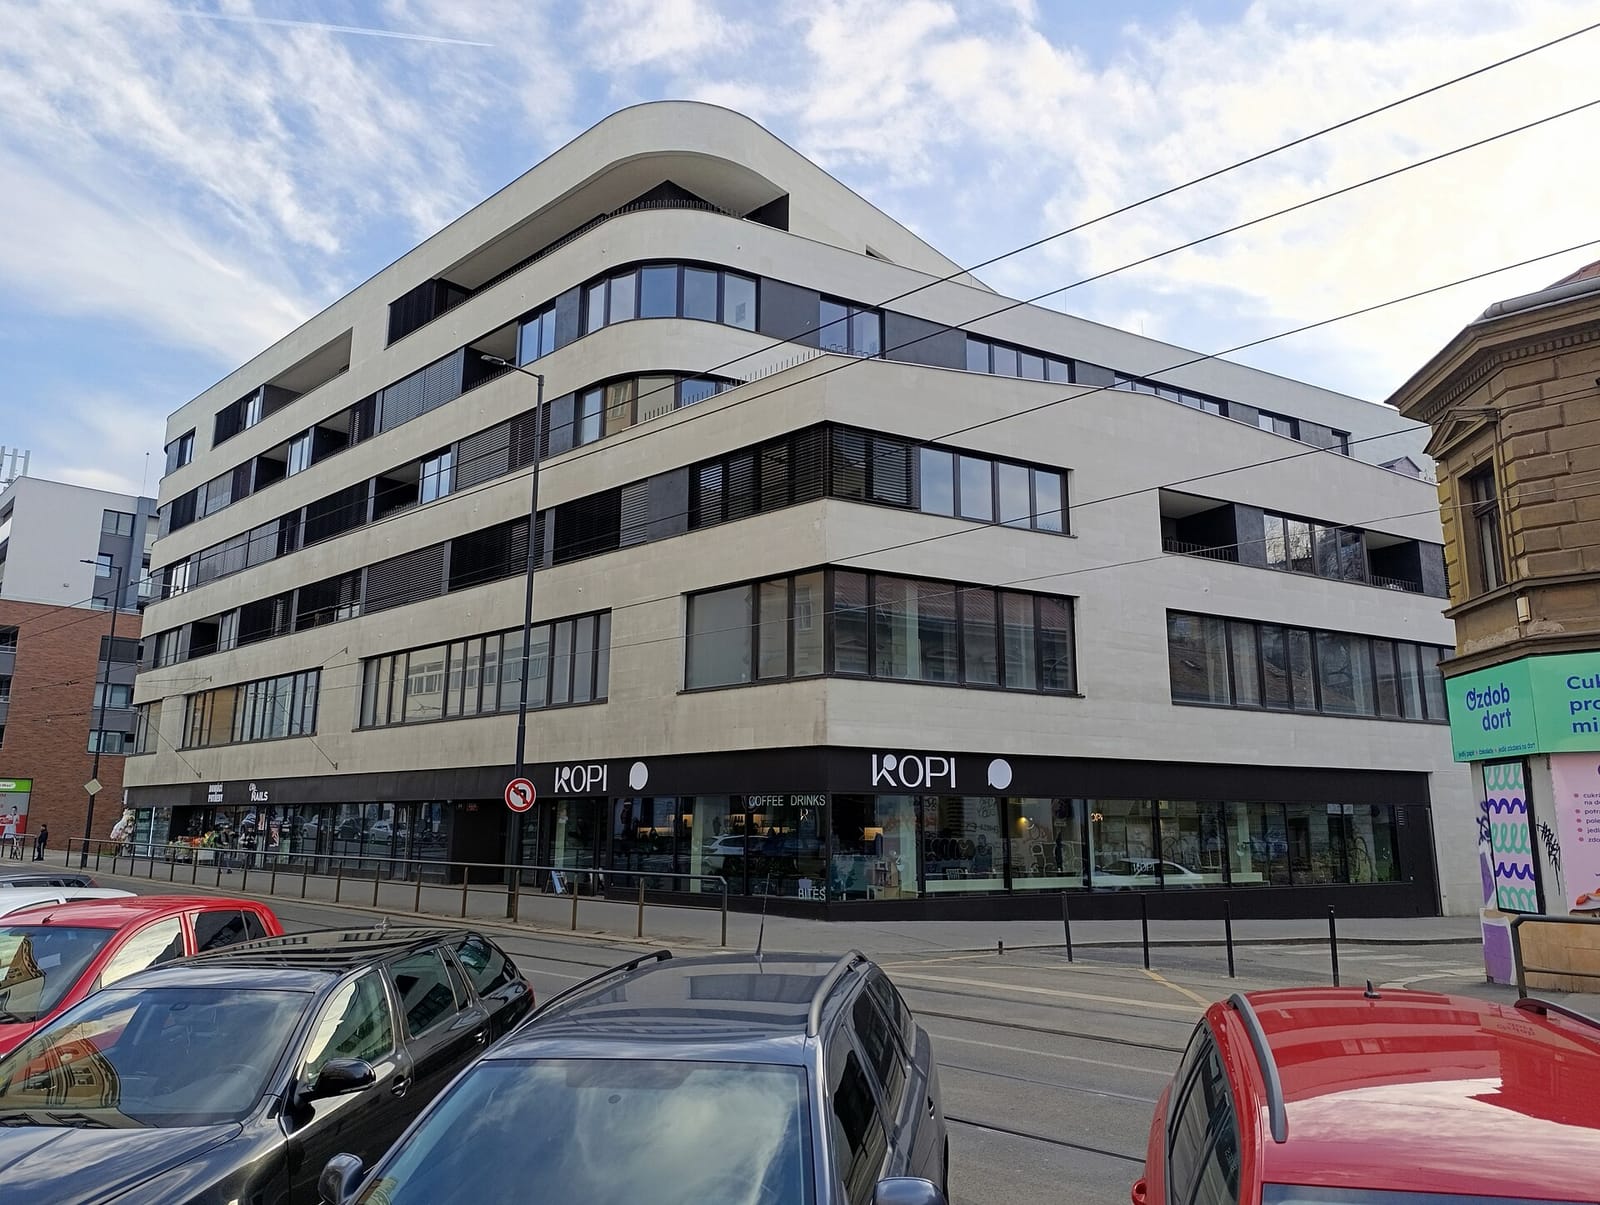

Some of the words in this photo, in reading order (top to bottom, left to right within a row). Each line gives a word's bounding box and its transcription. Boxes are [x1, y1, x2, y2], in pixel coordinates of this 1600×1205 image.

[1466, 682, 1510, 710] Ozdob
[1482, 708, 1511, 731] dort
[554, 764, 608, 793] KOPI
[872, 753, 956, 788] KOPI
[748, 795, 784, 807] COFFEE
[790, 794, 826, 806] DRINKS
[799, 888, 826, 901] BITES
